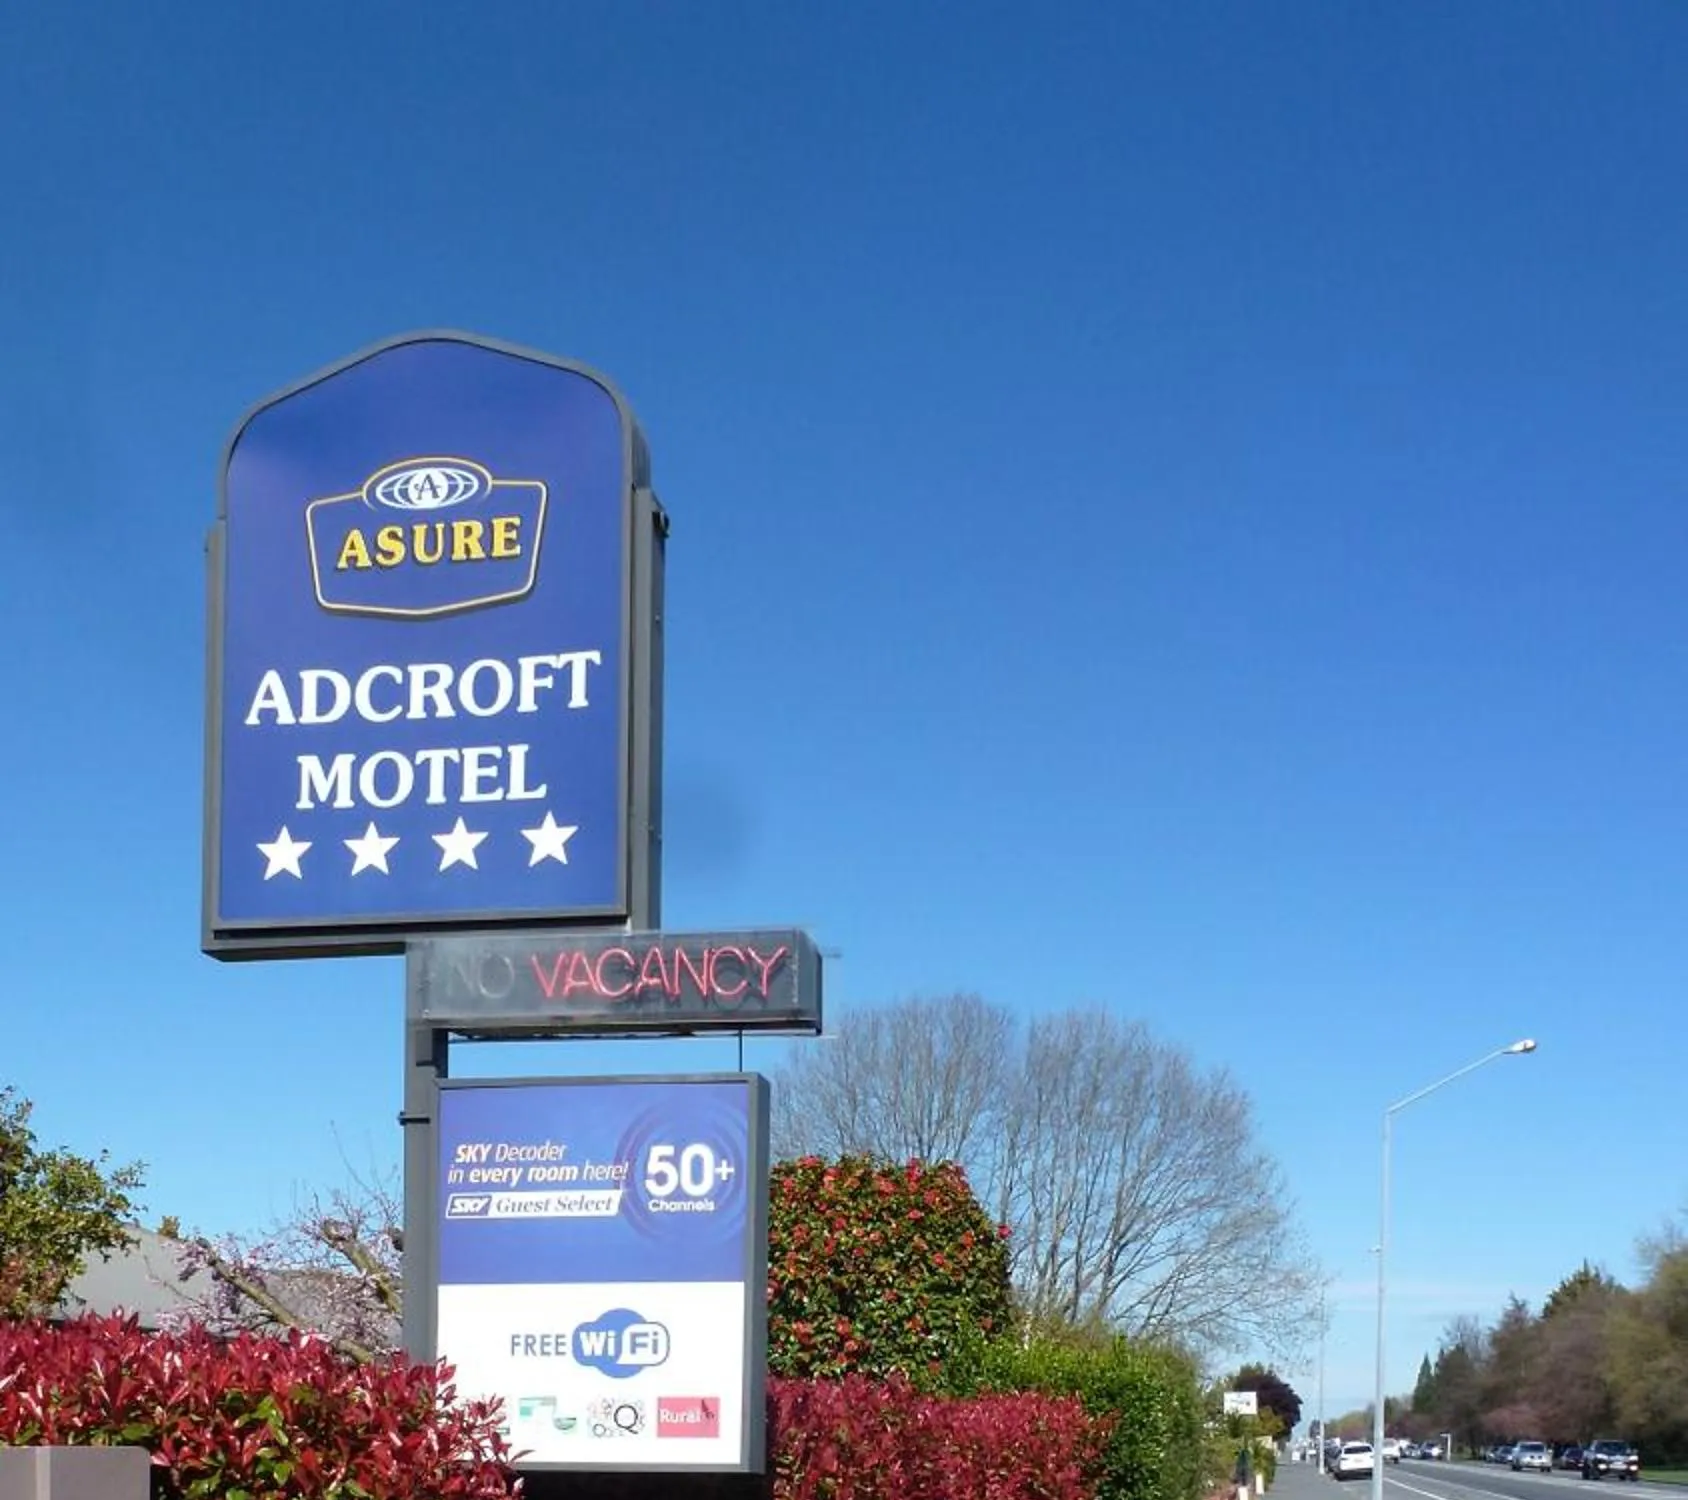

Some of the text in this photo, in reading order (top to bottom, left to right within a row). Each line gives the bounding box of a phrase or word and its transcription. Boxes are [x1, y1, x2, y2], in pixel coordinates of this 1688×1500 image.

[336, 516, 522, 570] ASURE
[244, 650, 601, 726] ADCROFT
[296, 744, 548, 810] MOTEL
[447, 944, 788, 999] NO VACANCY
[455, 1140, 567, 1163] SKY Decoder
[644, 1143, 735, 1197] 50+
[448, 1160, 629, 1188] in every room here!
[451, 1193, 615, 1213] SKY Guest Select
[648, 1197, 715, 1213] Channels
[511, 1333, 567, 1357] FREE
